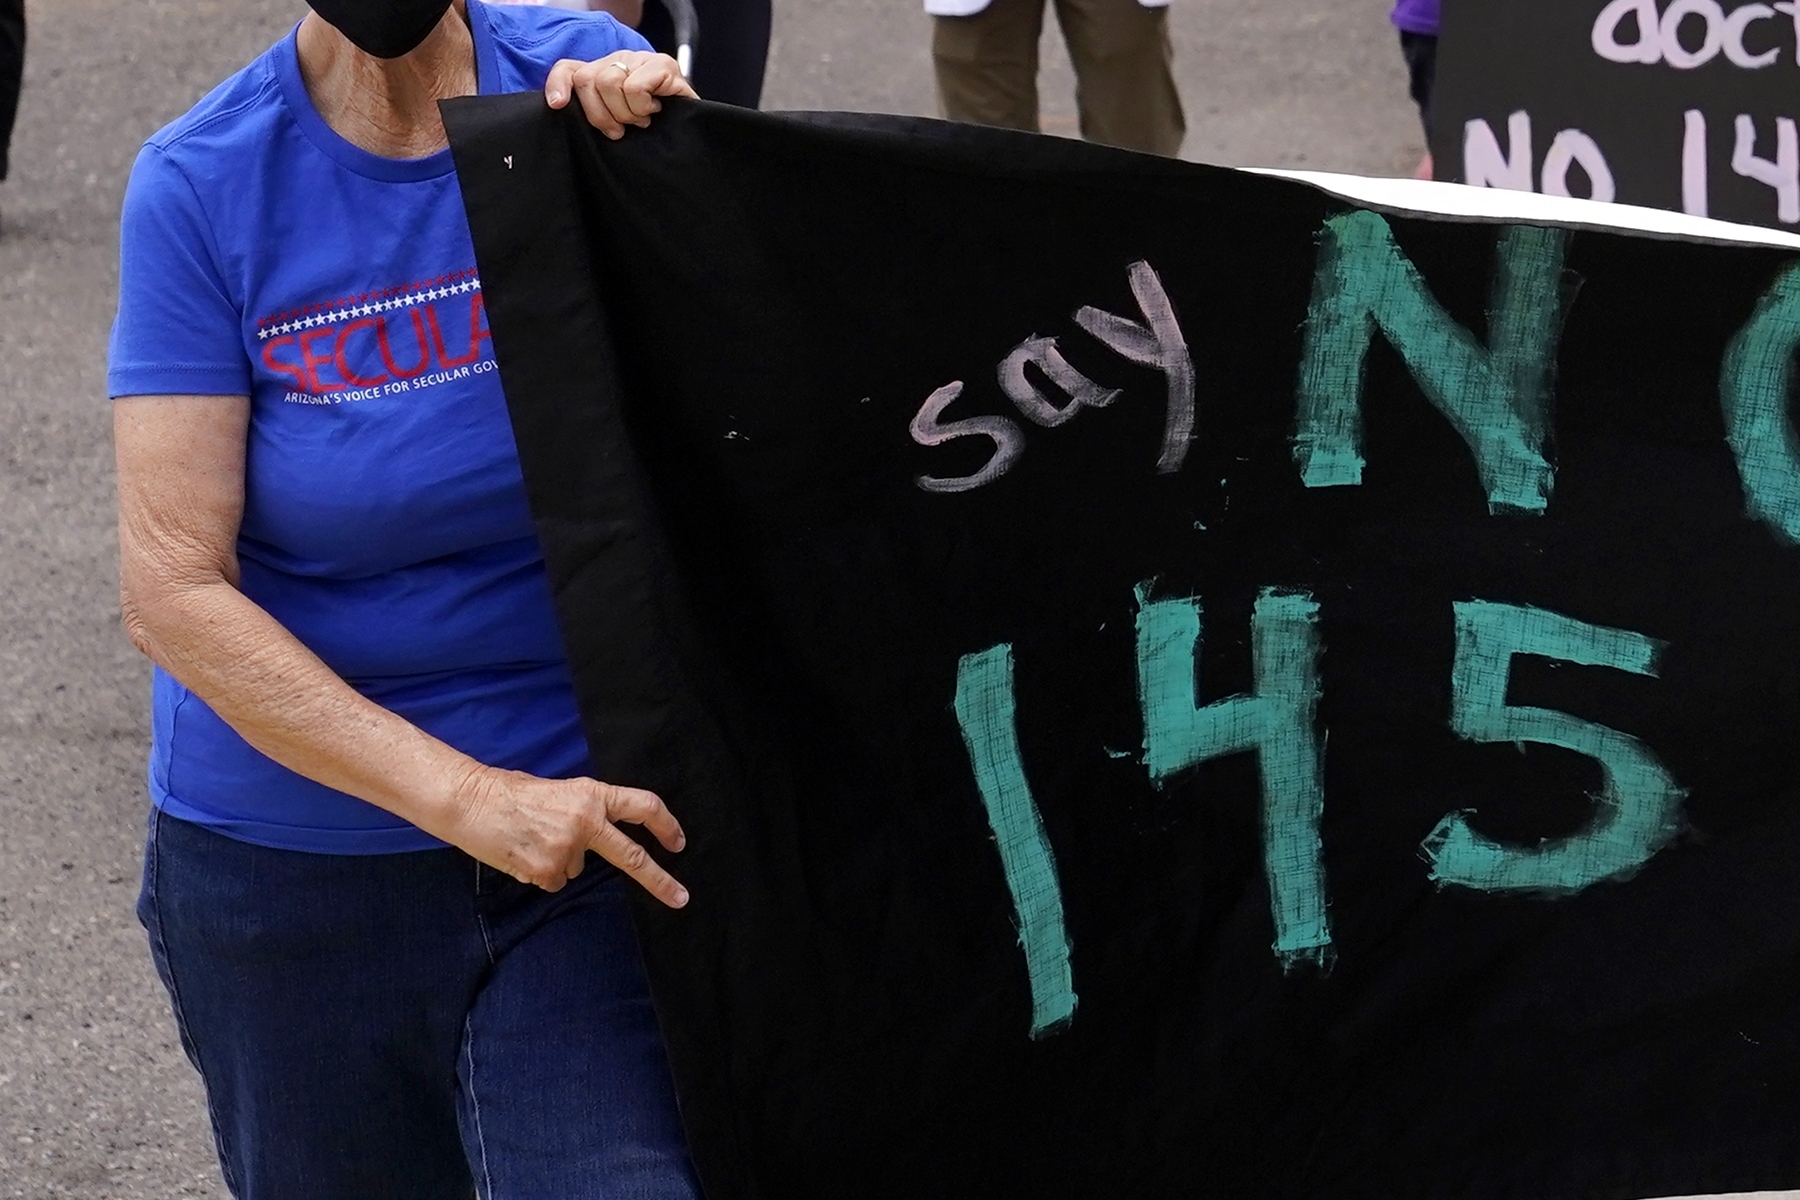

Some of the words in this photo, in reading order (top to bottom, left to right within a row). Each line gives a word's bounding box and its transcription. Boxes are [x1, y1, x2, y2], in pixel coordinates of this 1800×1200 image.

[261, 293, 491, 395] SECULA
[284, 390, 341, 406] ARIZONA'S
[342, 386, 381, 402] VOICE
[384, 381, 410, 395] FOR
[413, 366, 470, 390] SECULAR
[909, 260, 1198, 494] say
